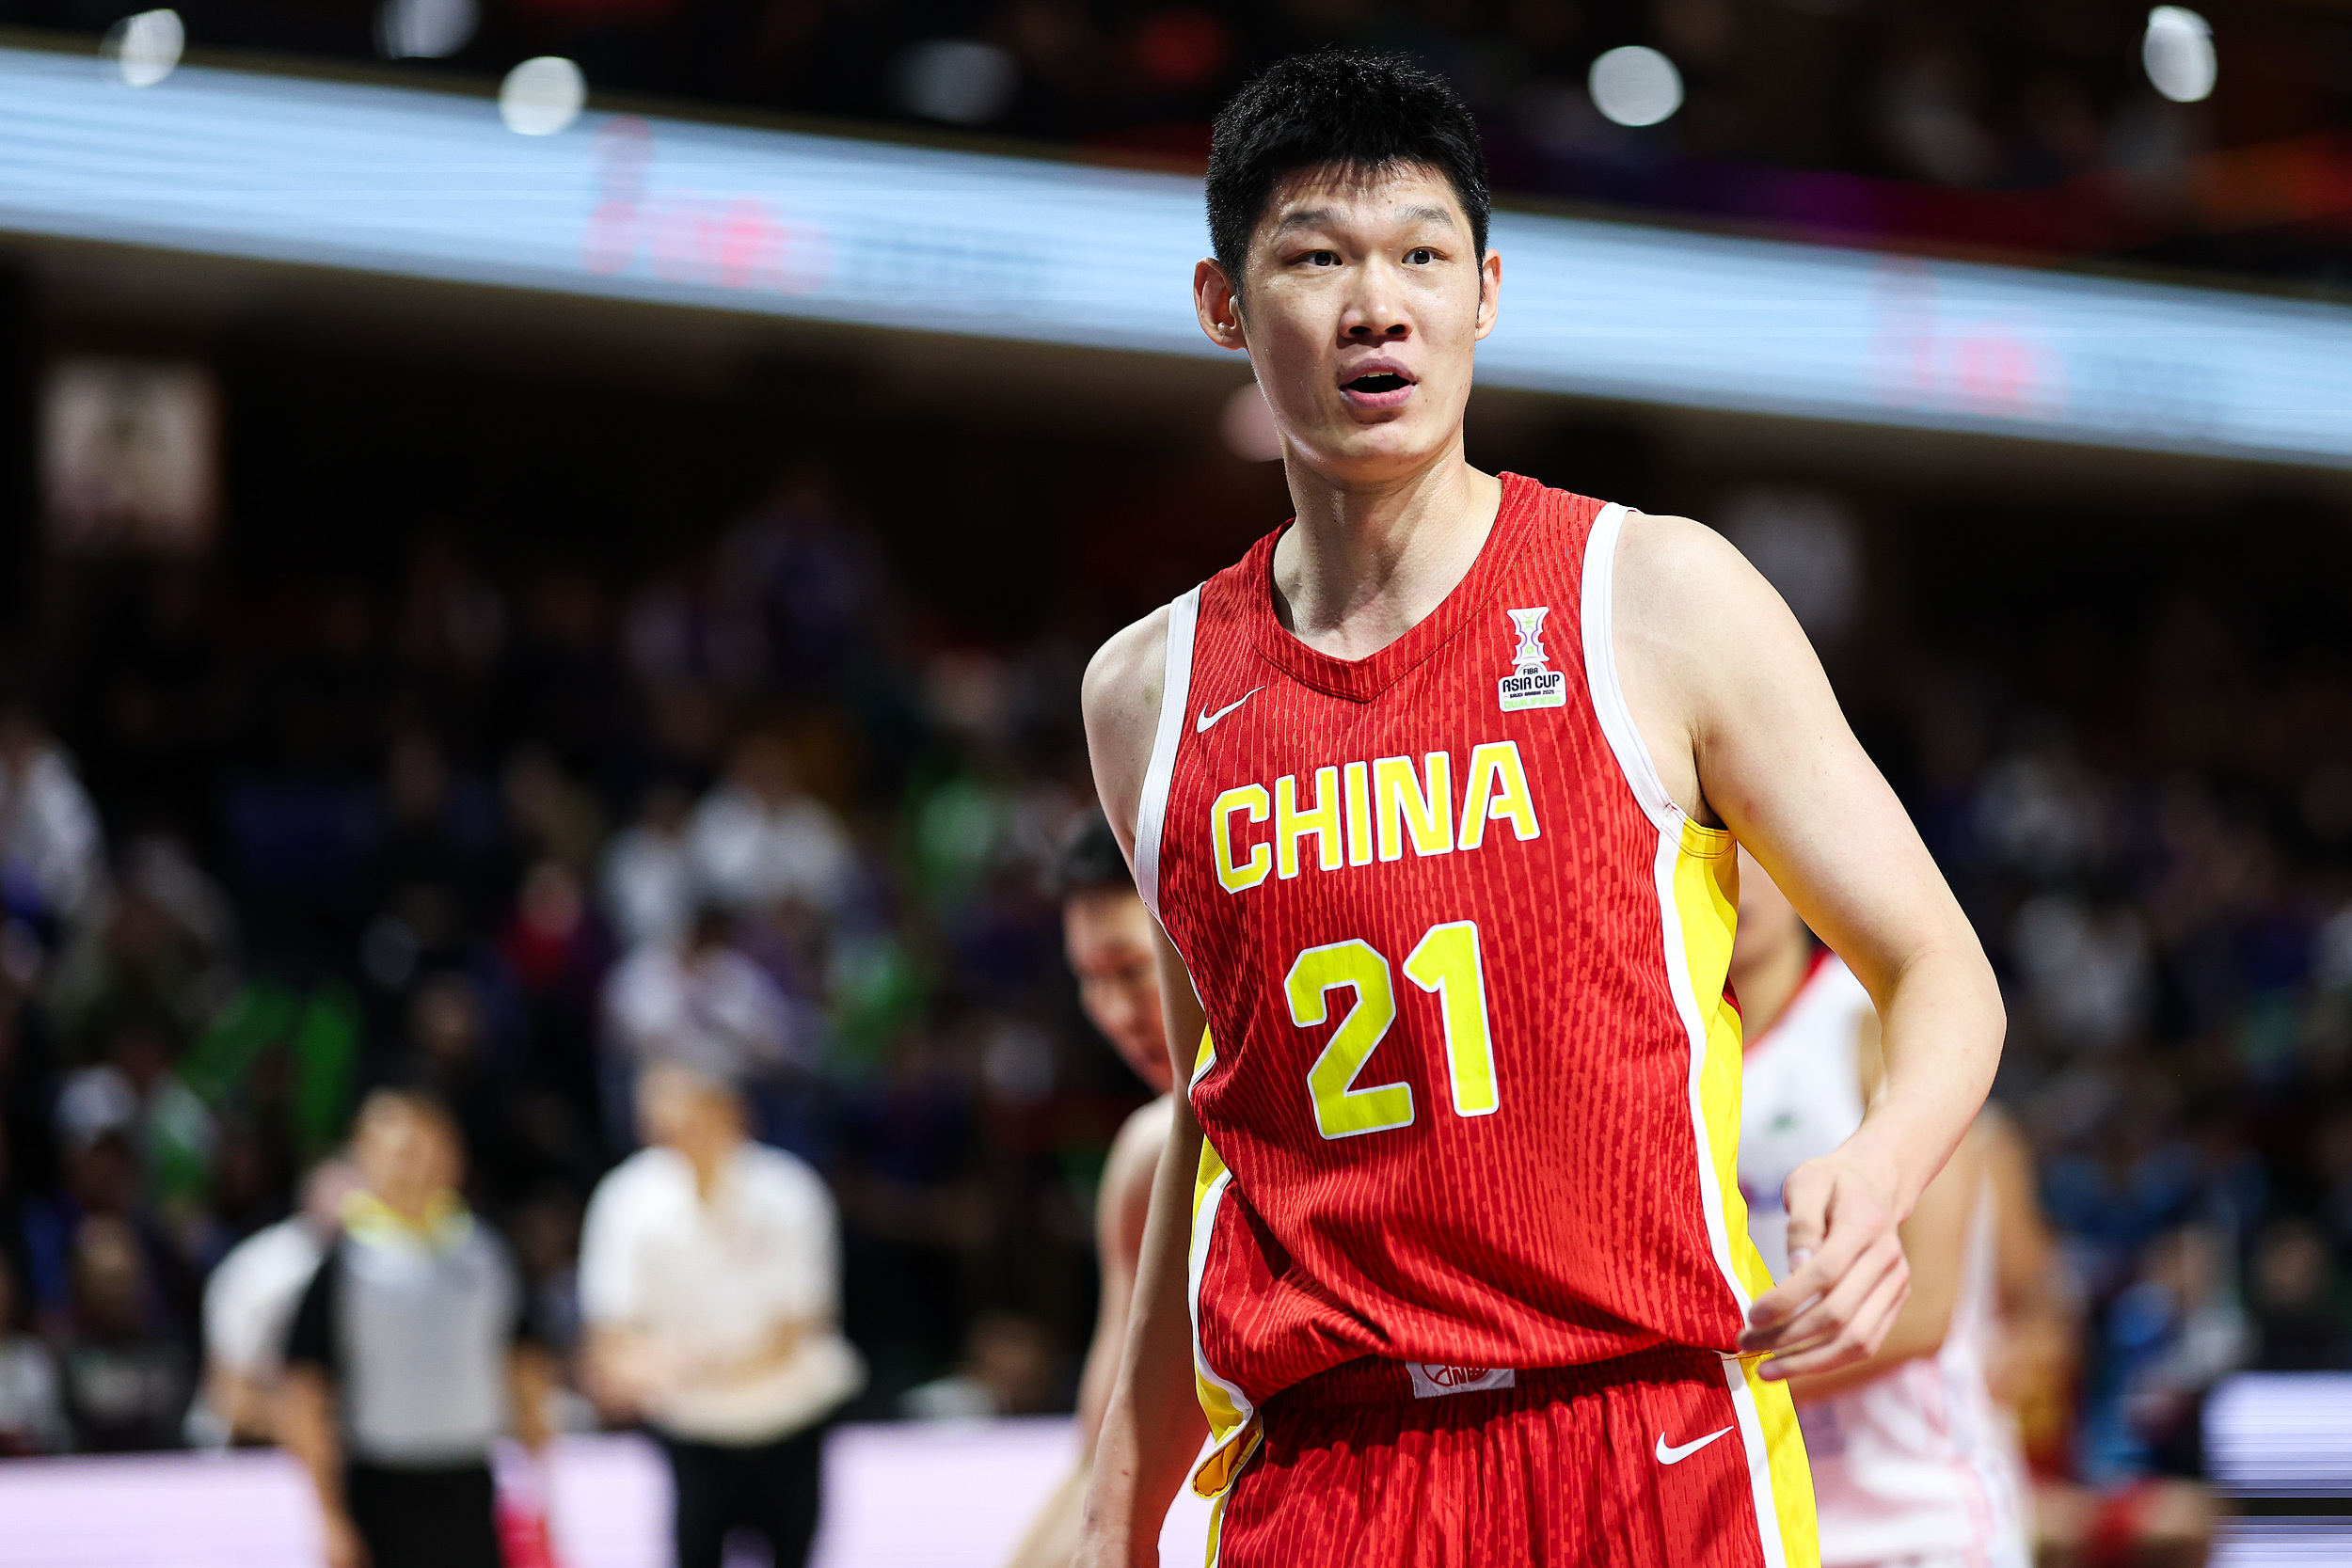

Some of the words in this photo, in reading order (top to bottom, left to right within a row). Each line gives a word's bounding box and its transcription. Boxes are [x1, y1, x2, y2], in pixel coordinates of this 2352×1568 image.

[1523, 667, 1538, 675] FIBA
[1502, 676, 1532, 692] ASIA
[1534, 674, 1560, 689] CUP
[1504, 696, 1561, 709] QUALIFIERS
[1211, 740, 1541, 895] CHINA
[1284, 919, 1500, 1140] 21
